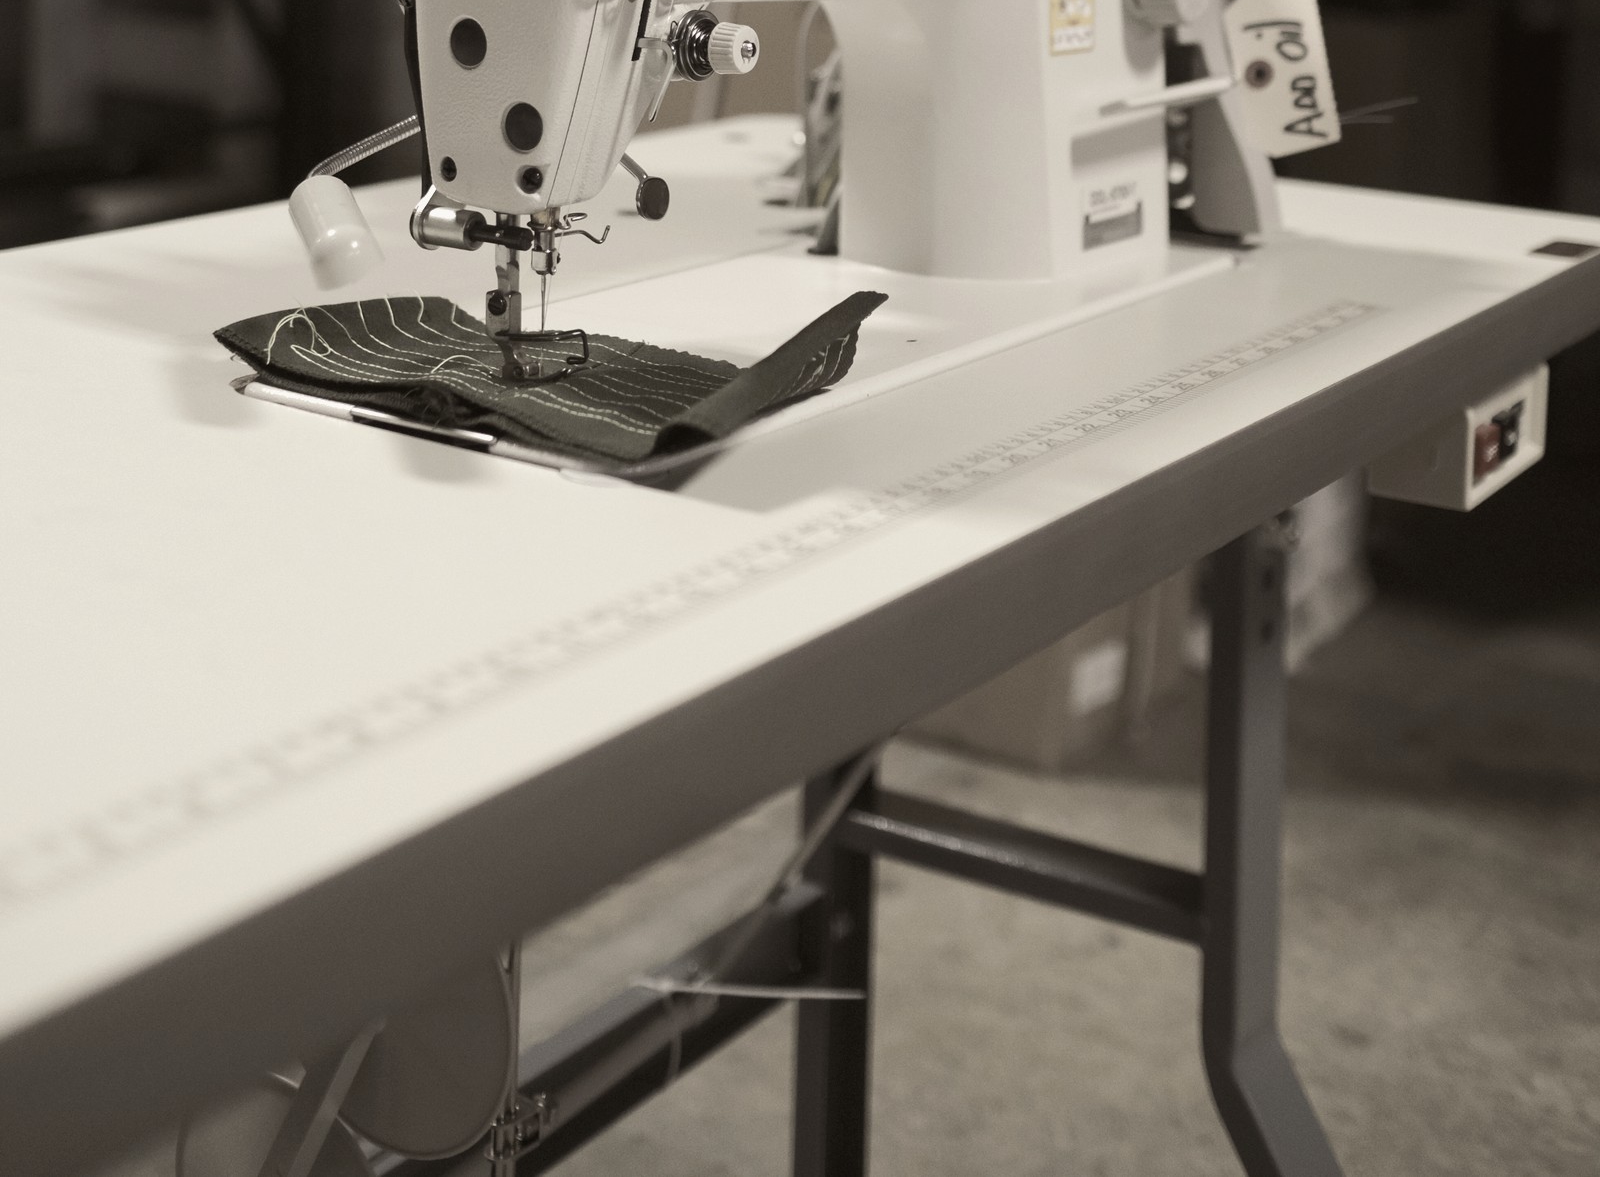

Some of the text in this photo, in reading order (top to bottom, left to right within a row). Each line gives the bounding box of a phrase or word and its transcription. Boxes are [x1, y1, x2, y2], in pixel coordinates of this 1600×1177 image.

[1073, 423, 1098, 432] 22
[1107, 408, 1133, 418] 23
[1139, 394, 1164, 404] 24
[1171, 381, 1195, 390] 25
